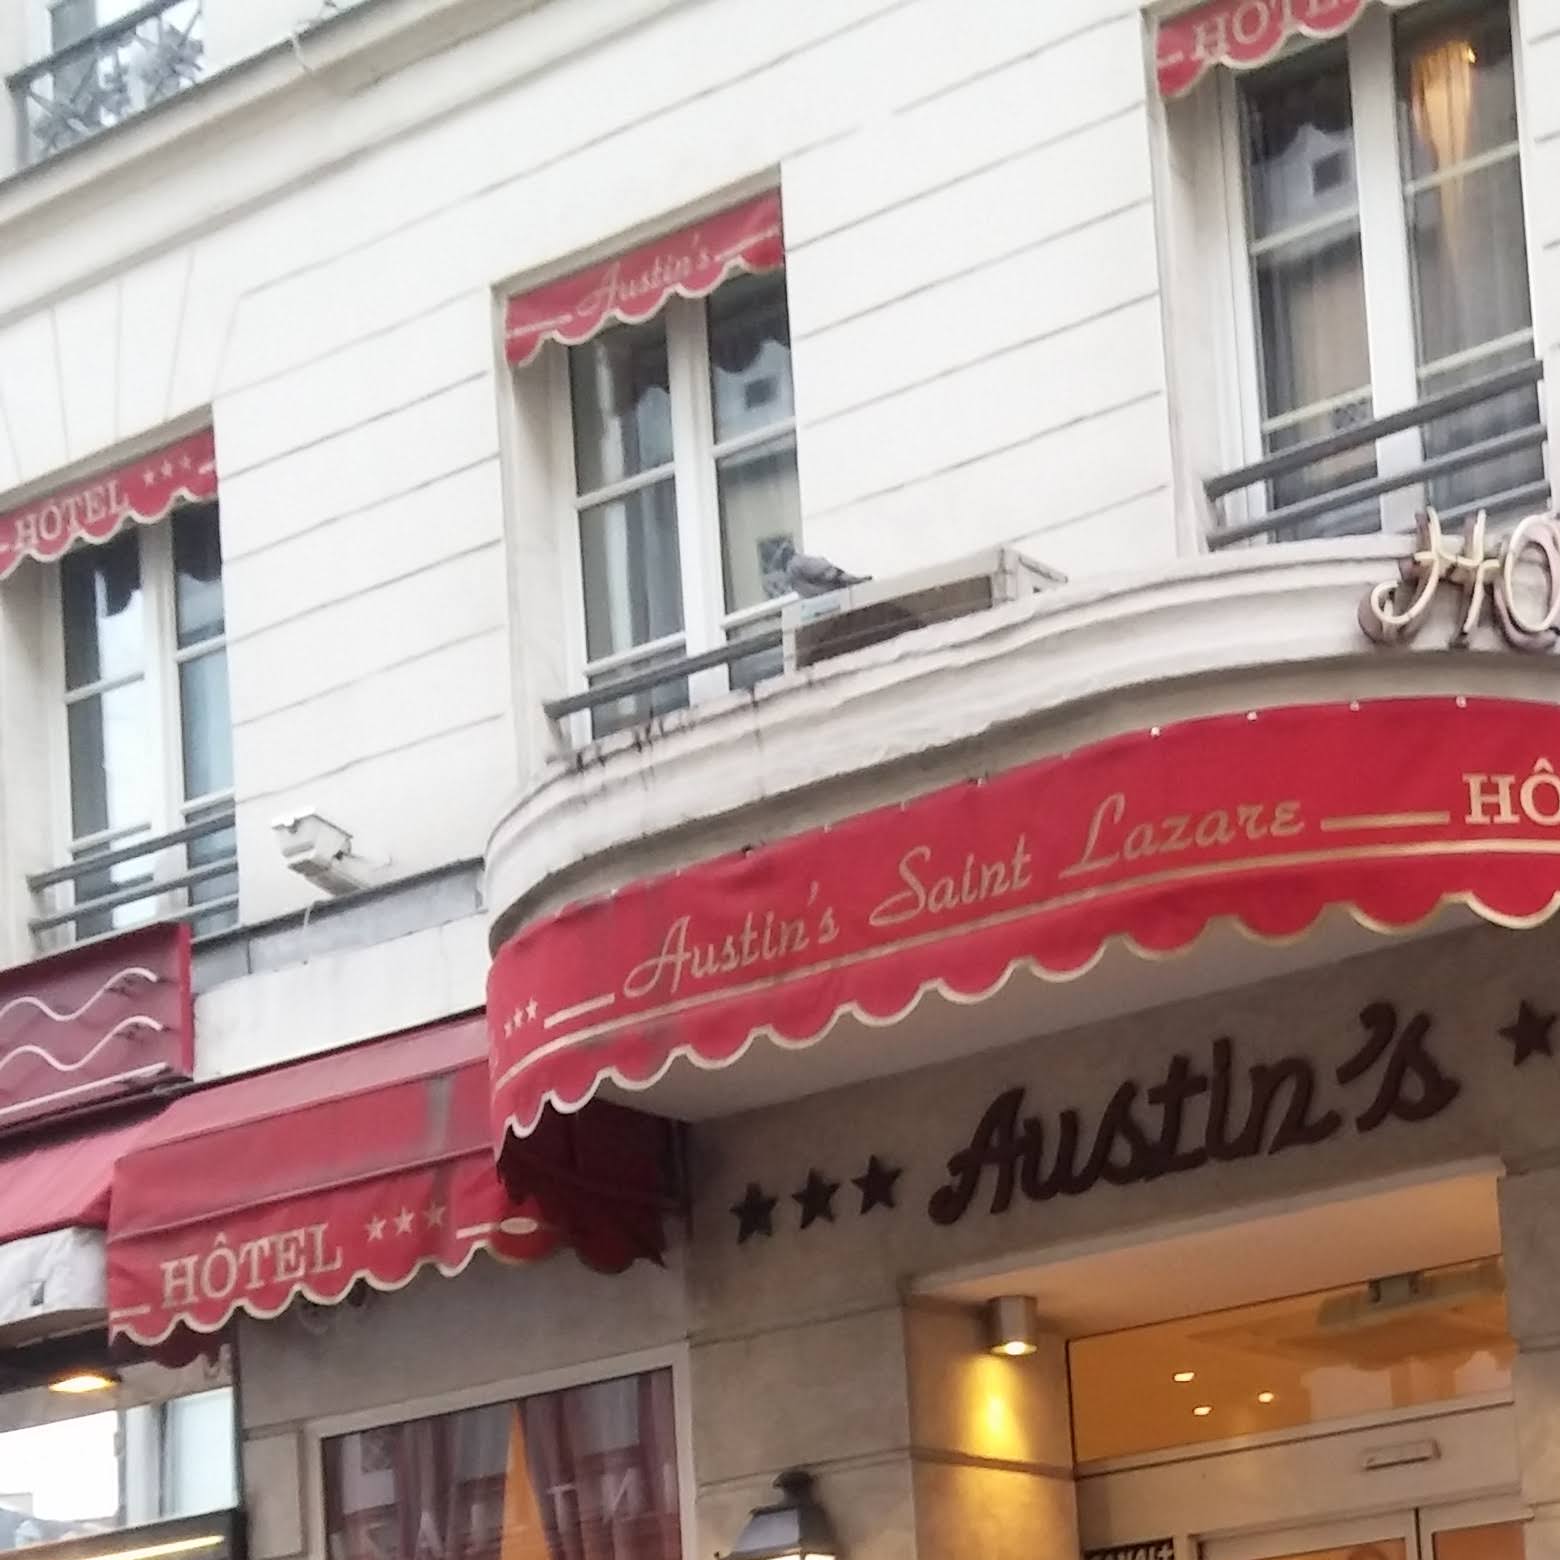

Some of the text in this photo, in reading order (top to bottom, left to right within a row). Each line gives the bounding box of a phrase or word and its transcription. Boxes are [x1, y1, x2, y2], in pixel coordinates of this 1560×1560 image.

[1192, 0, 1362, 60] HOT
[575, 232, 713, 309] Austin's
[624, 882, 839, 999] Austin's
[869, 834, 1032, 927] Saint
[1059, 792, 1304, 881] Lazare
[927, 1001, 1461, 1226] Austin's
[159, 1231, 343, 1309] HÔTEL
